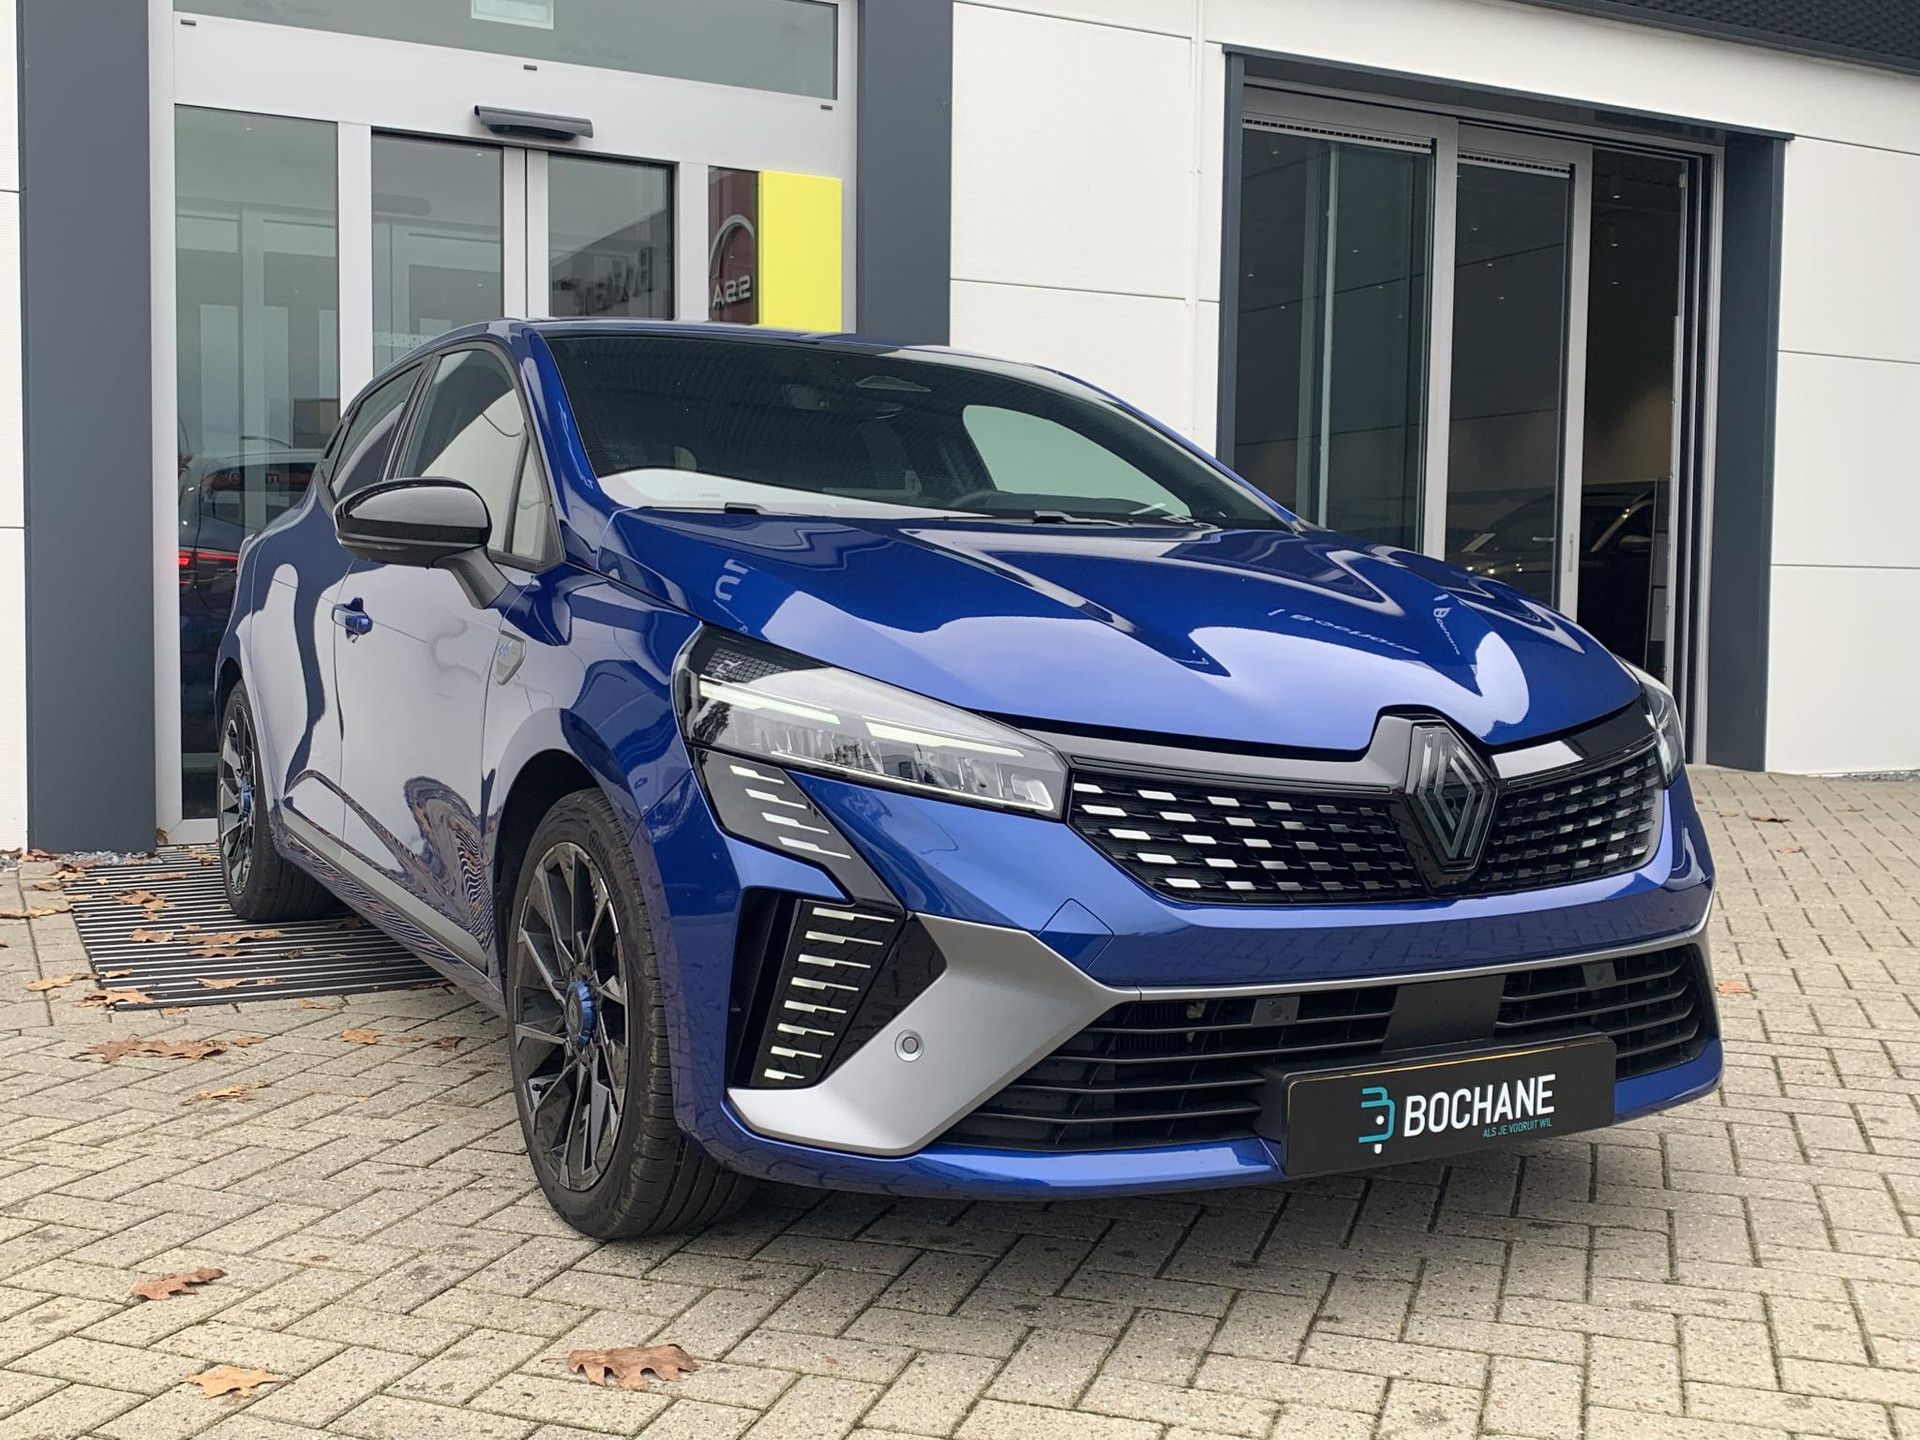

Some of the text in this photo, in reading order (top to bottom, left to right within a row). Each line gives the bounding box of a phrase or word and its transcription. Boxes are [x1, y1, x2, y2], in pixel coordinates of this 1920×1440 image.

[1404, 1074, 1556, 1137] BOCHANE
[1483, 1118, 1553, 1138] ALS JE VOORUIT WIL
